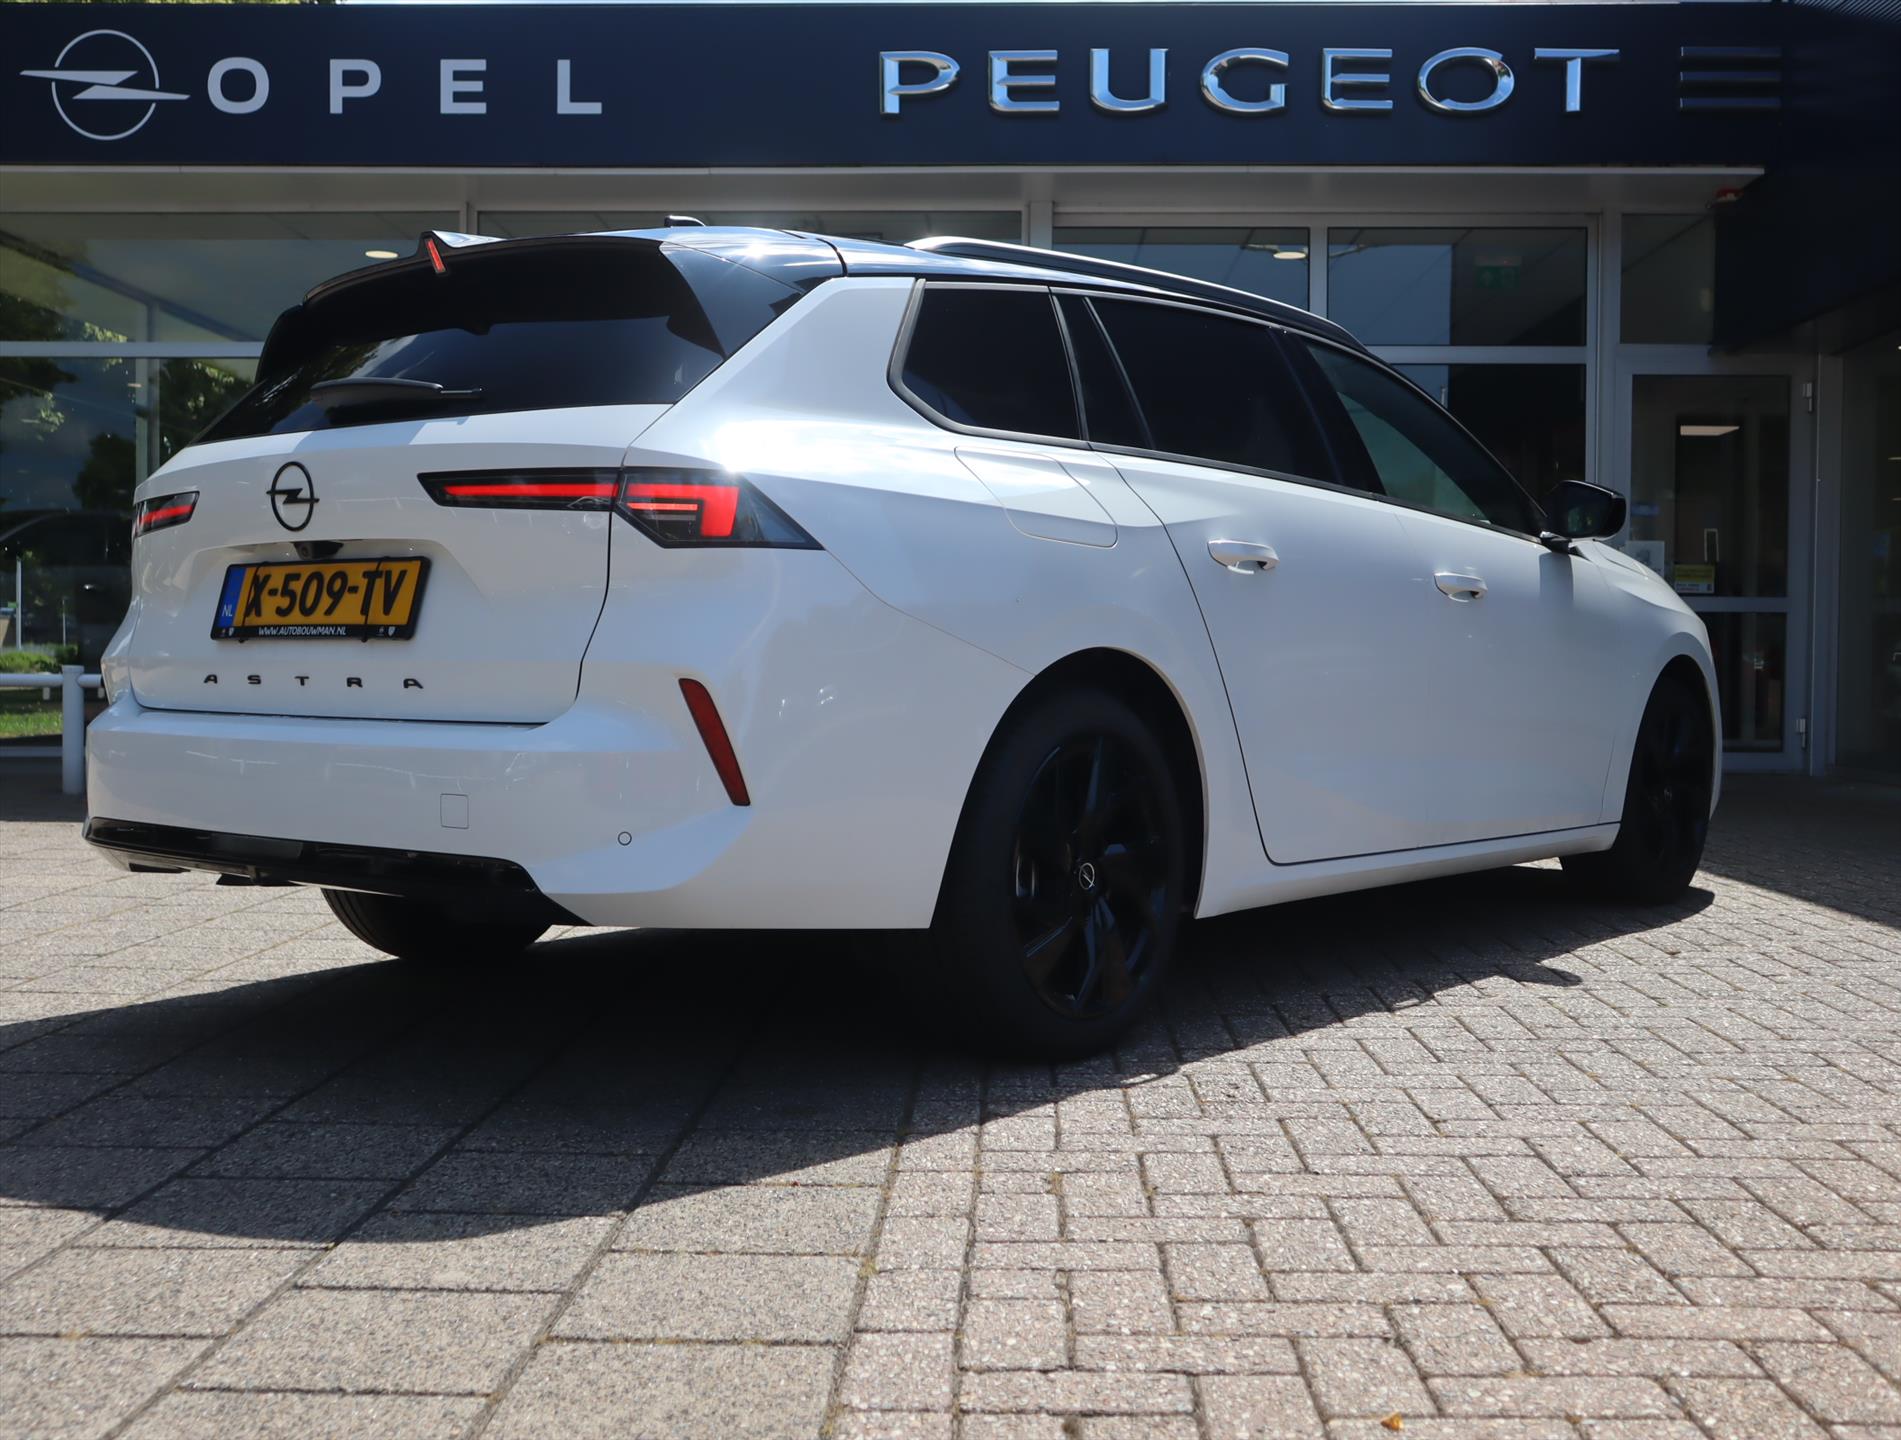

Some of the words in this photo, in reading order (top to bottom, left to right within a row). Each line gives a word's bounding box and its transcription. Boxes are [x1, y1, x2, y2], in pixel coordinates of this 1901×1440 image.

[207, 57, 602, 115] OPEL
[879, 47, 1619, 115] PEUGEOT
[246, 570, 407, 617] X-509-TV
[222, 604, 233, 617] NL
[258, 626, 347, 636] WWW.AUTOBOUWMAN.NL
[204, 674, 423, 689] ASTRA
